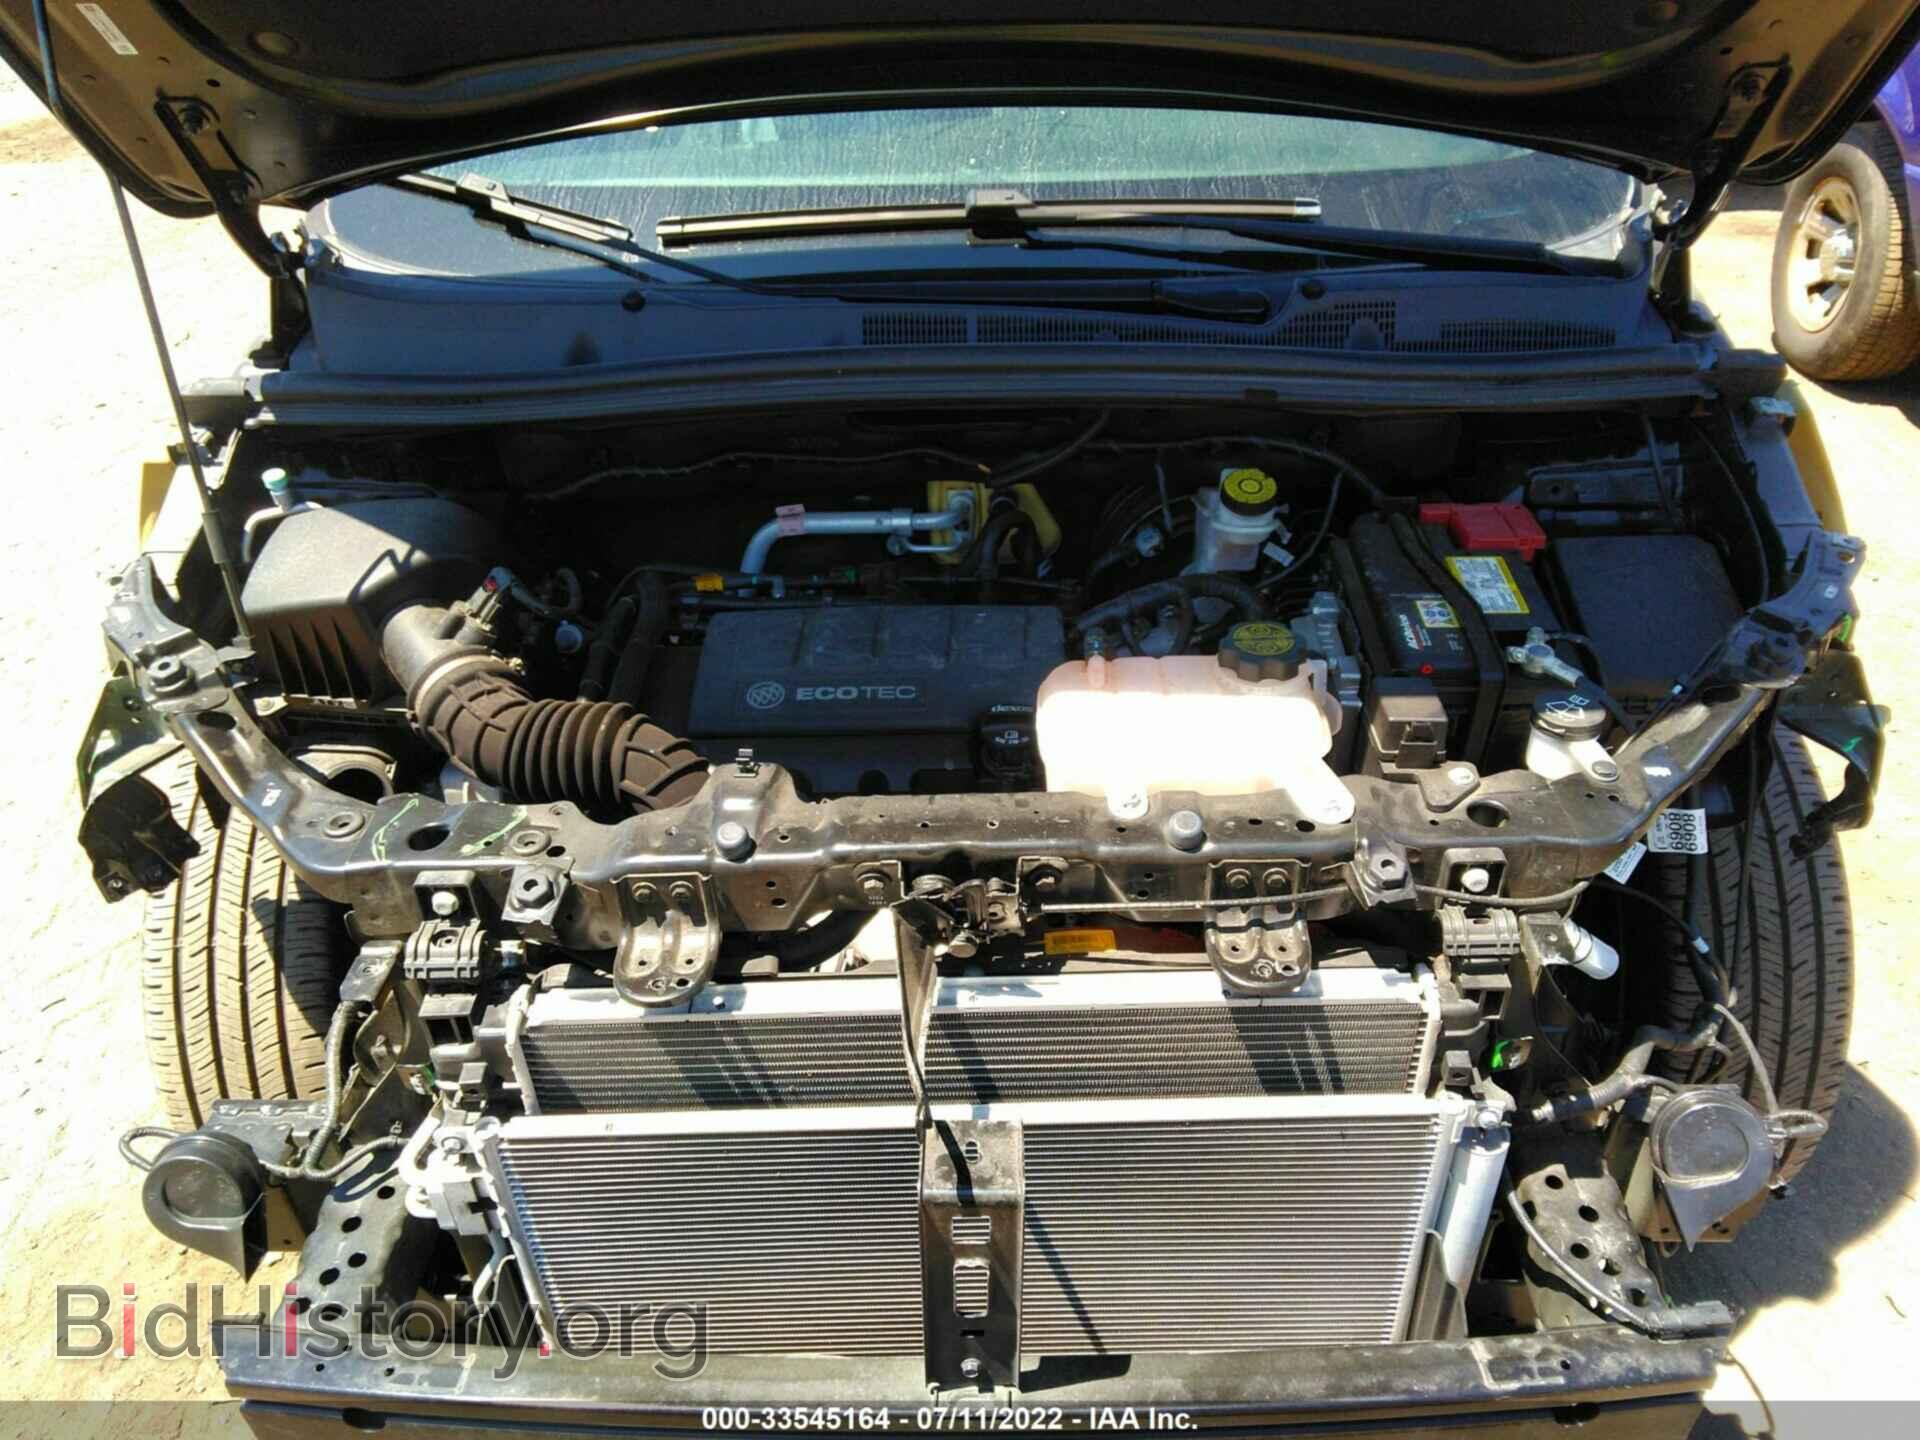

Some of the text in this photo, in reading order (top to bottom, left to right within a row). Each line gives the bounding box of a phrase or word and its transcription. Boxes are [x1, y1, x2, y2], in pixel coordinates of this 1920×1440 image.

[796, 686, 916, 700] ECOTEC
[1669, 812, 1684, 850] 8069
[1682, 813, 1697, 851] 8069
